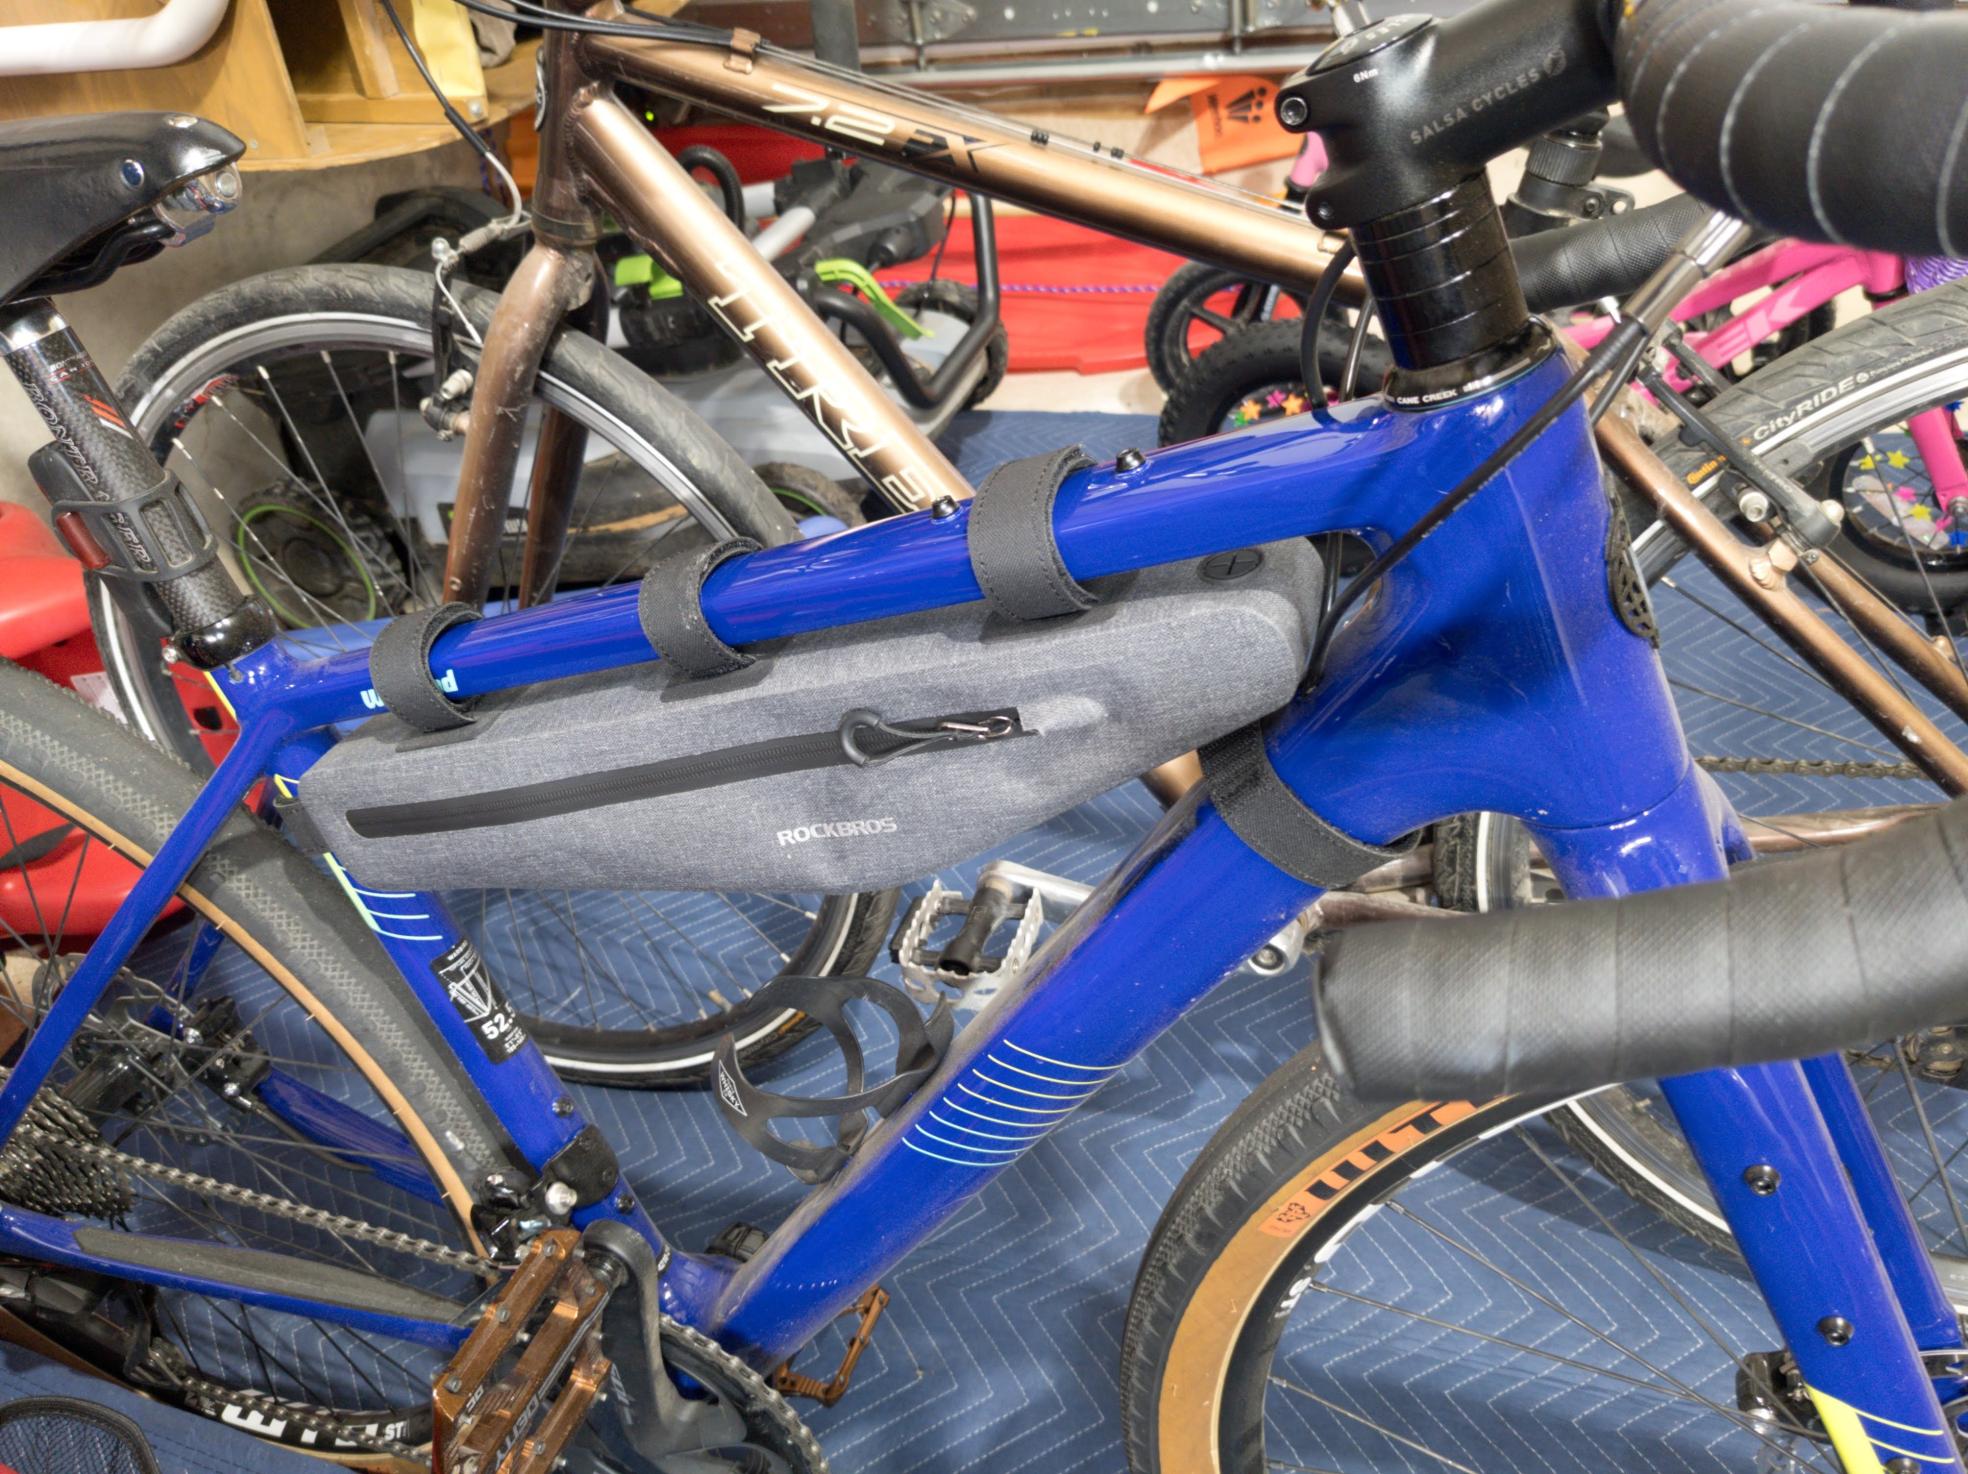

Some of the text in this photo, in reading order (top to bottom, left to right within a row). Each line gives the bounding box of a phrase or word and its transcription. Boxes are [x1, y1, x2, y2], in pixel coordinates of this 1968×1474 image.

[762, 82, 896, 147] 7.2
[1410, 67, 1541, 145] SALSA CYCLES
[1714, 285, 1806, 361] EK
[707, 258, 940, 515] TRE
[1422, 388, 1459, 404] CREEK
[1752, 375, 1856, 442] CityRIDE
[776, 816, 898, 846] ROCKBROS
